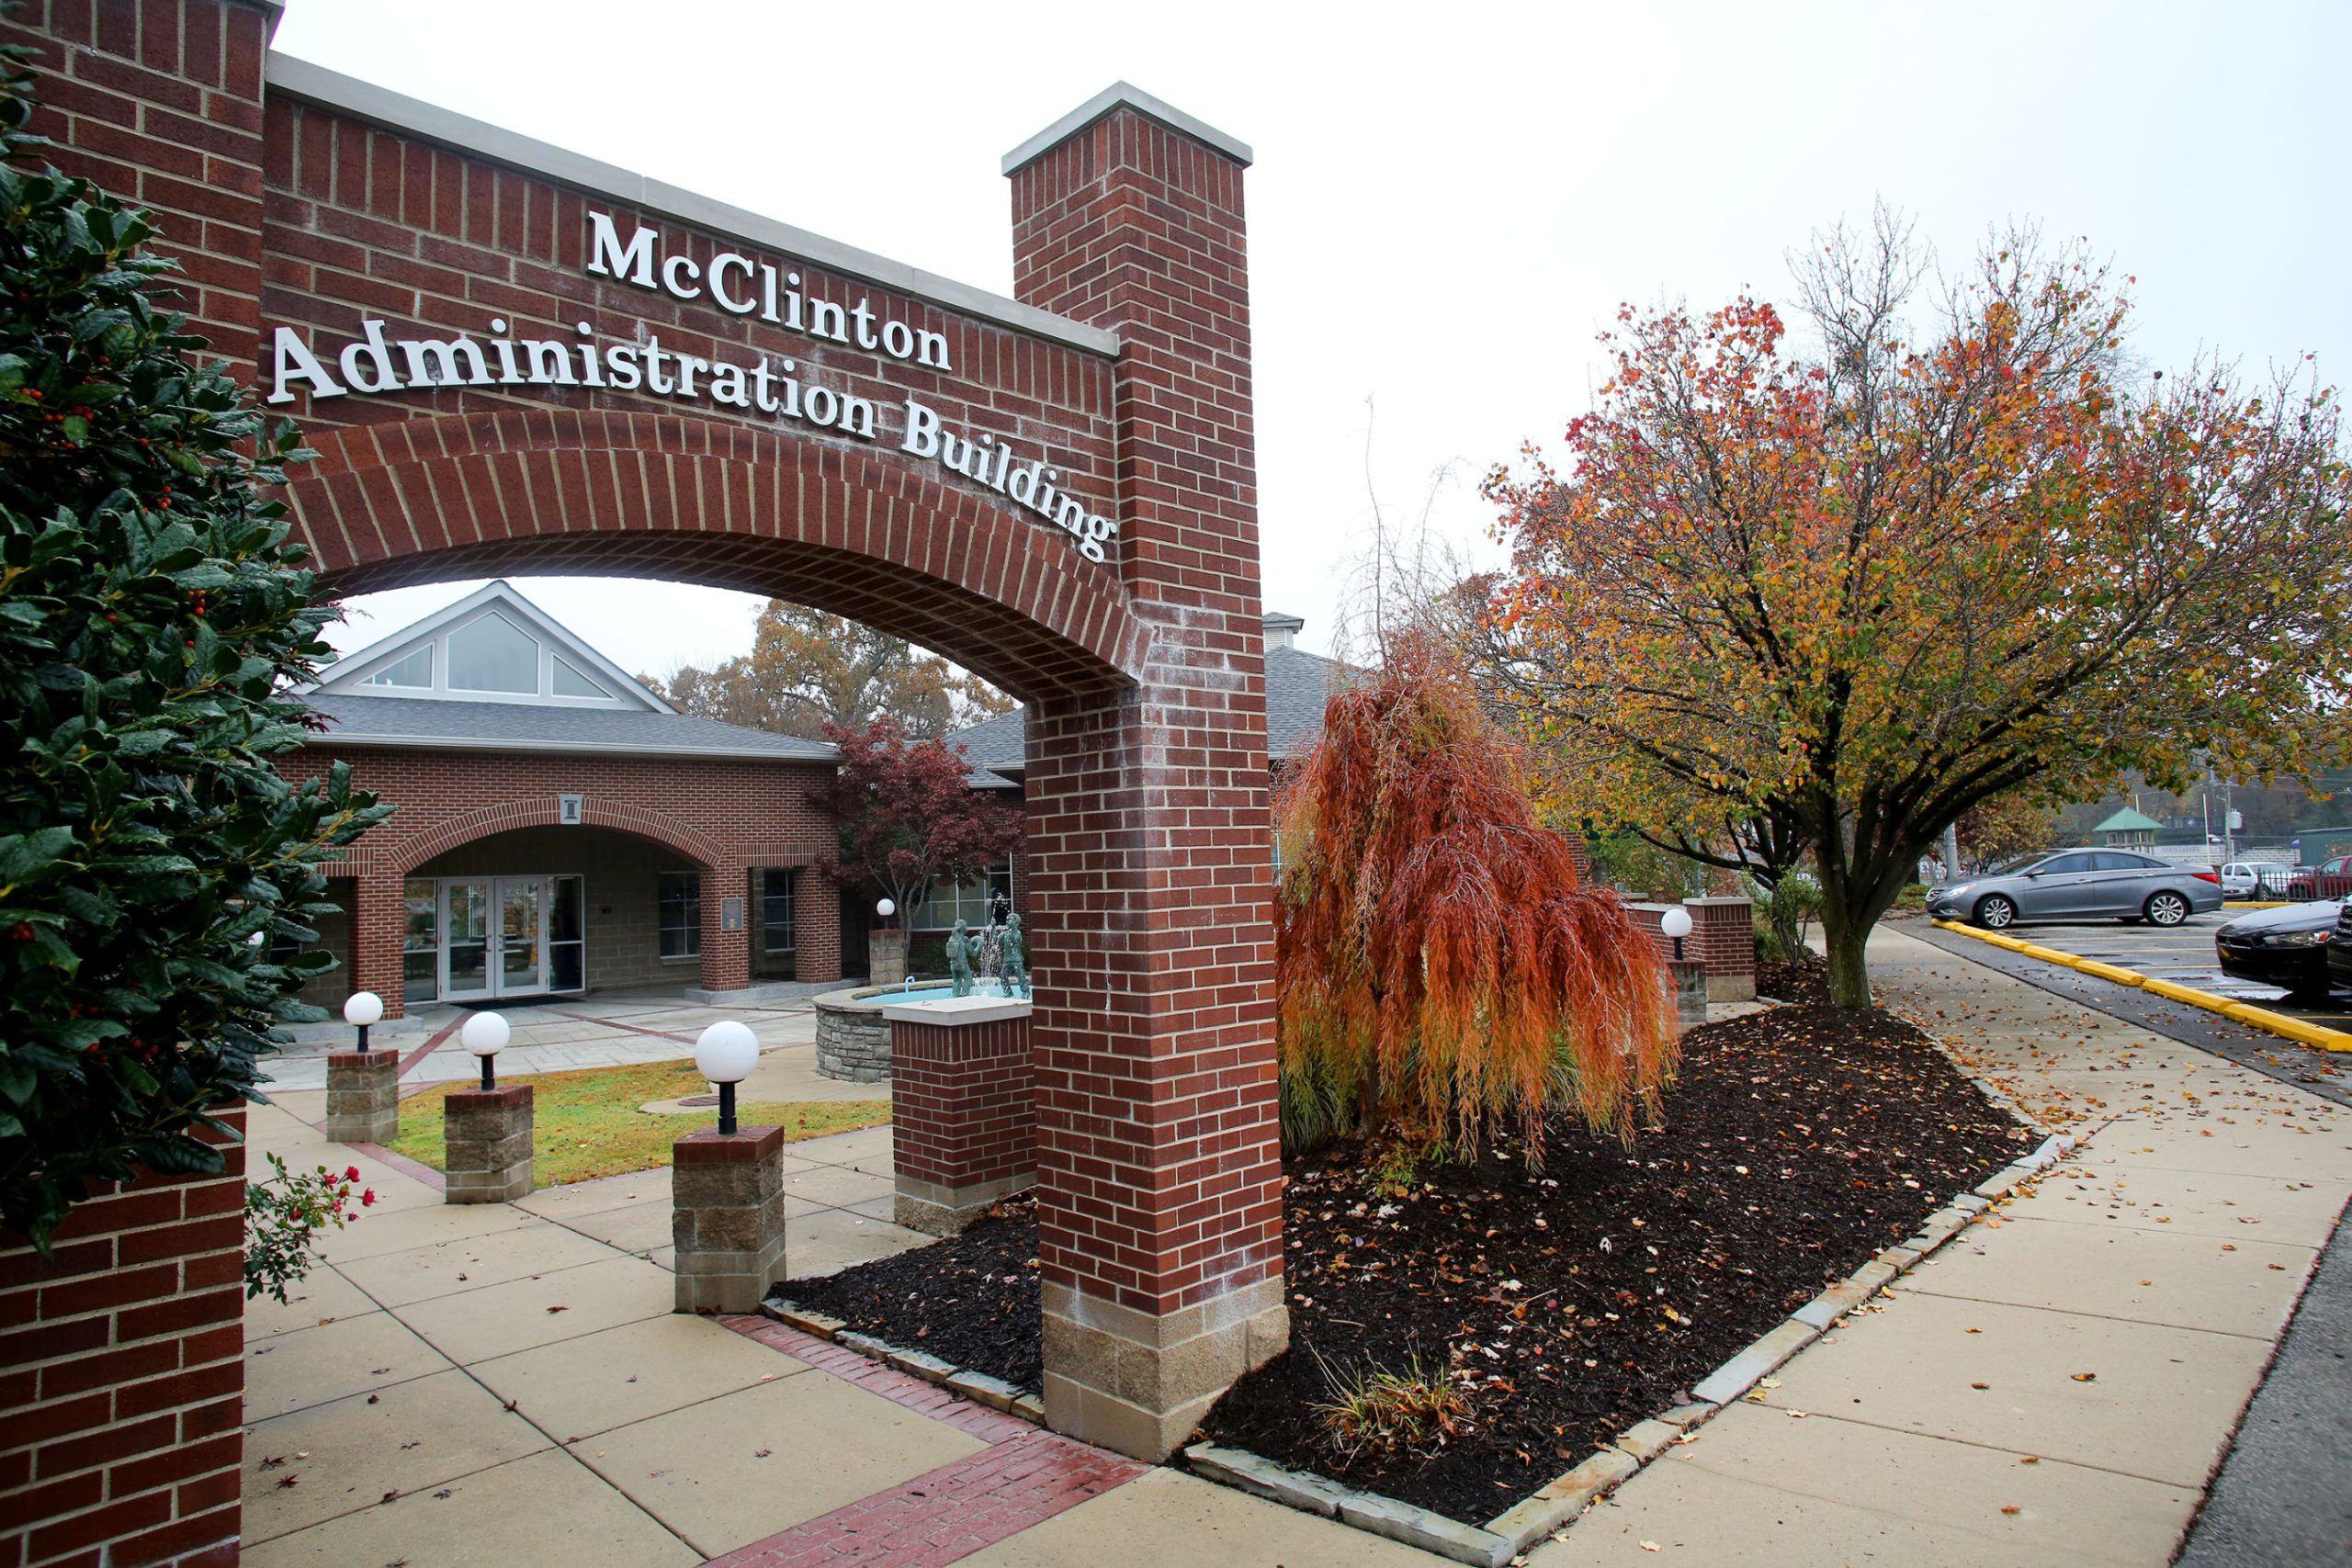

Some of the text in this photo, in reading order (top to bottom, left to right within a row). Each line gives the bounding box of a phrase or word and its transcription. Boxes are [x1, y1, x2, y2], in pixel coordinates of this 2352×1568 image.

[588, 210, 952, 371] McClinton
[266, 319, 1118, 564] Administration Building
